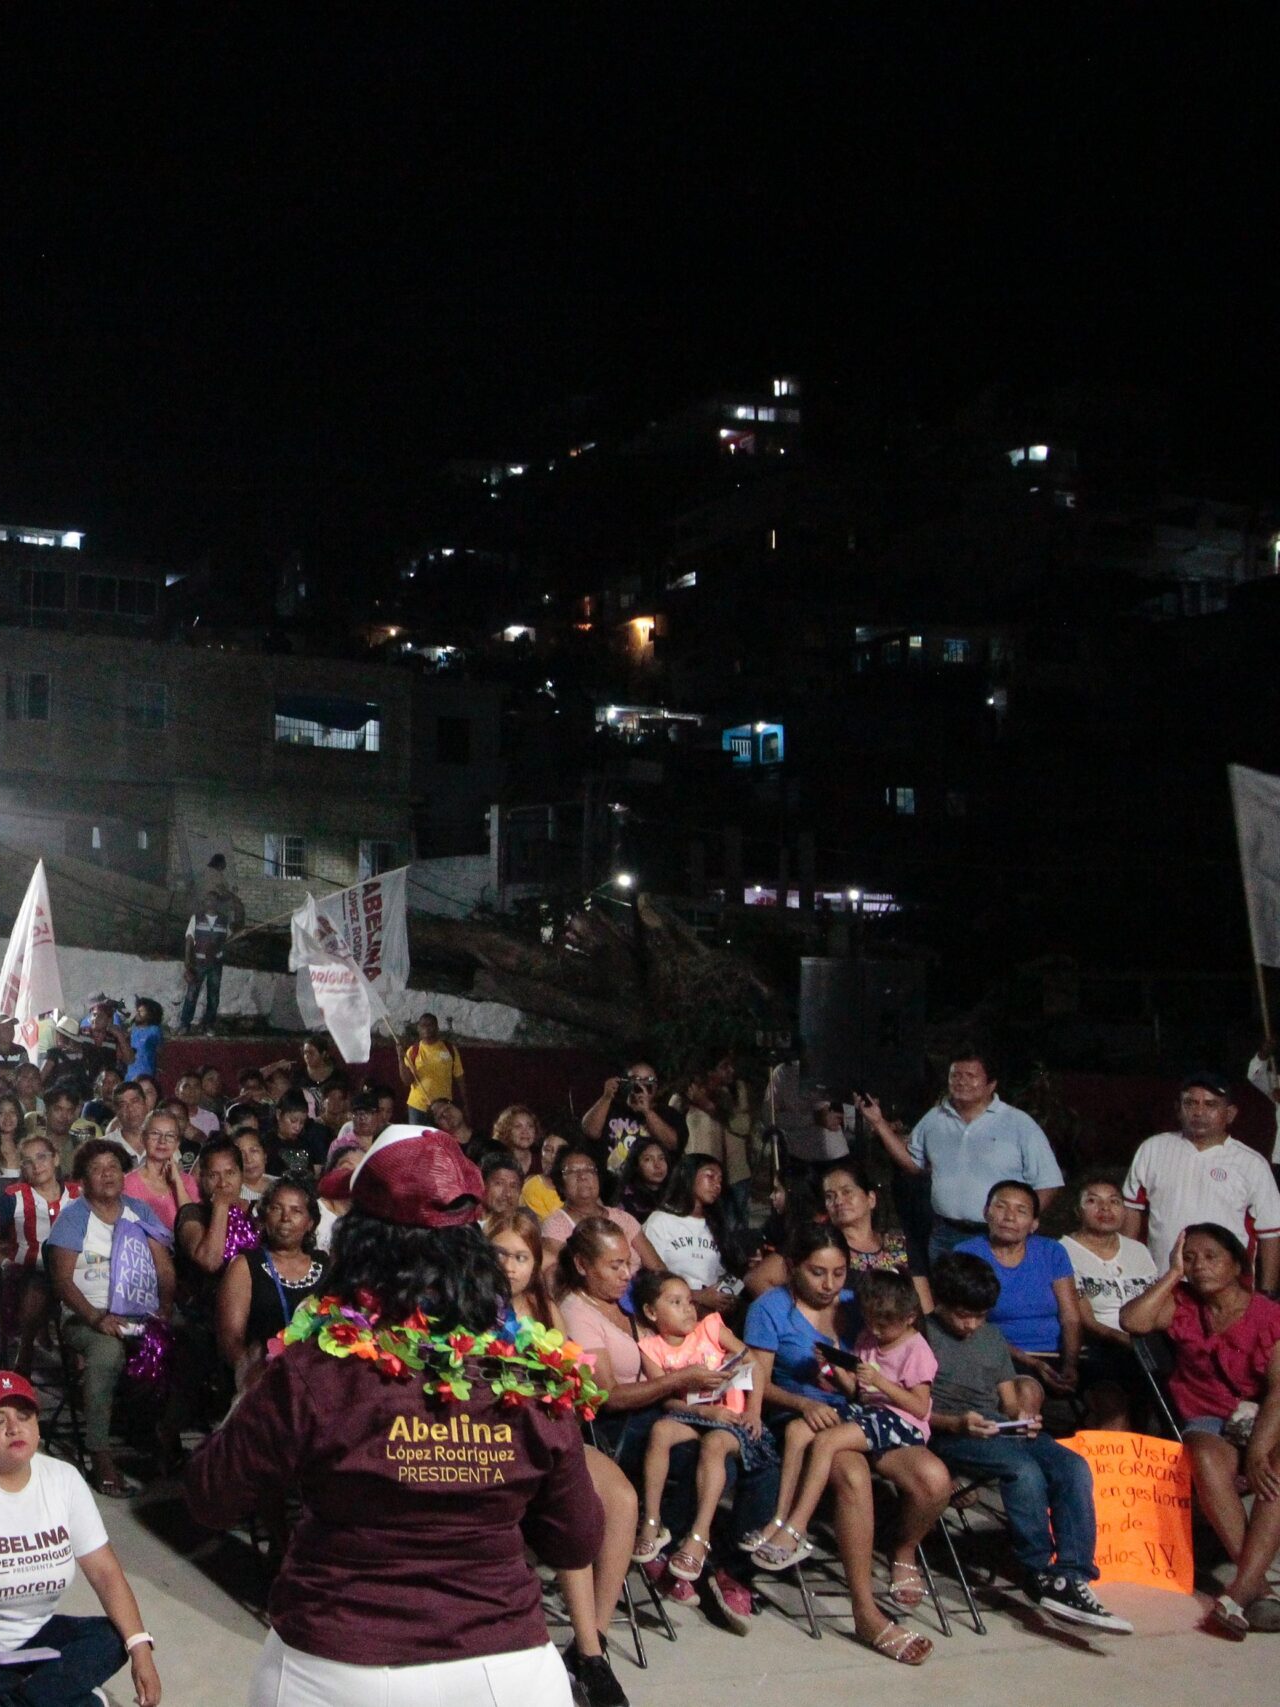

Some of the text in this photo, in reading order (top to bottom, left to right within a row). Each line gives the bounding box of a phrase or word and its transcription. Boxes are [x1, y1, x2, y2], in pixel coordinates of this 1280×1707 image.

[362, 882, 383, 983] ABELINA
[671, 1236, 694, 1251] NEW
[388, 1414, 513, 1444] Abelina
[386, 1444, 432, 1465] López
[1131, 1437, 1179, 1466] Vista
[398, 1466, 506, 1484] PRESIDENTA
[1118, 1460, 1187, 1485] GRACIAS
[1120, 1512, 1143, 1533] de
[17, 1545, 72, 1566] RODRÍGUEZ
[13, 1563, 55, 1574] PRESIDENTA
